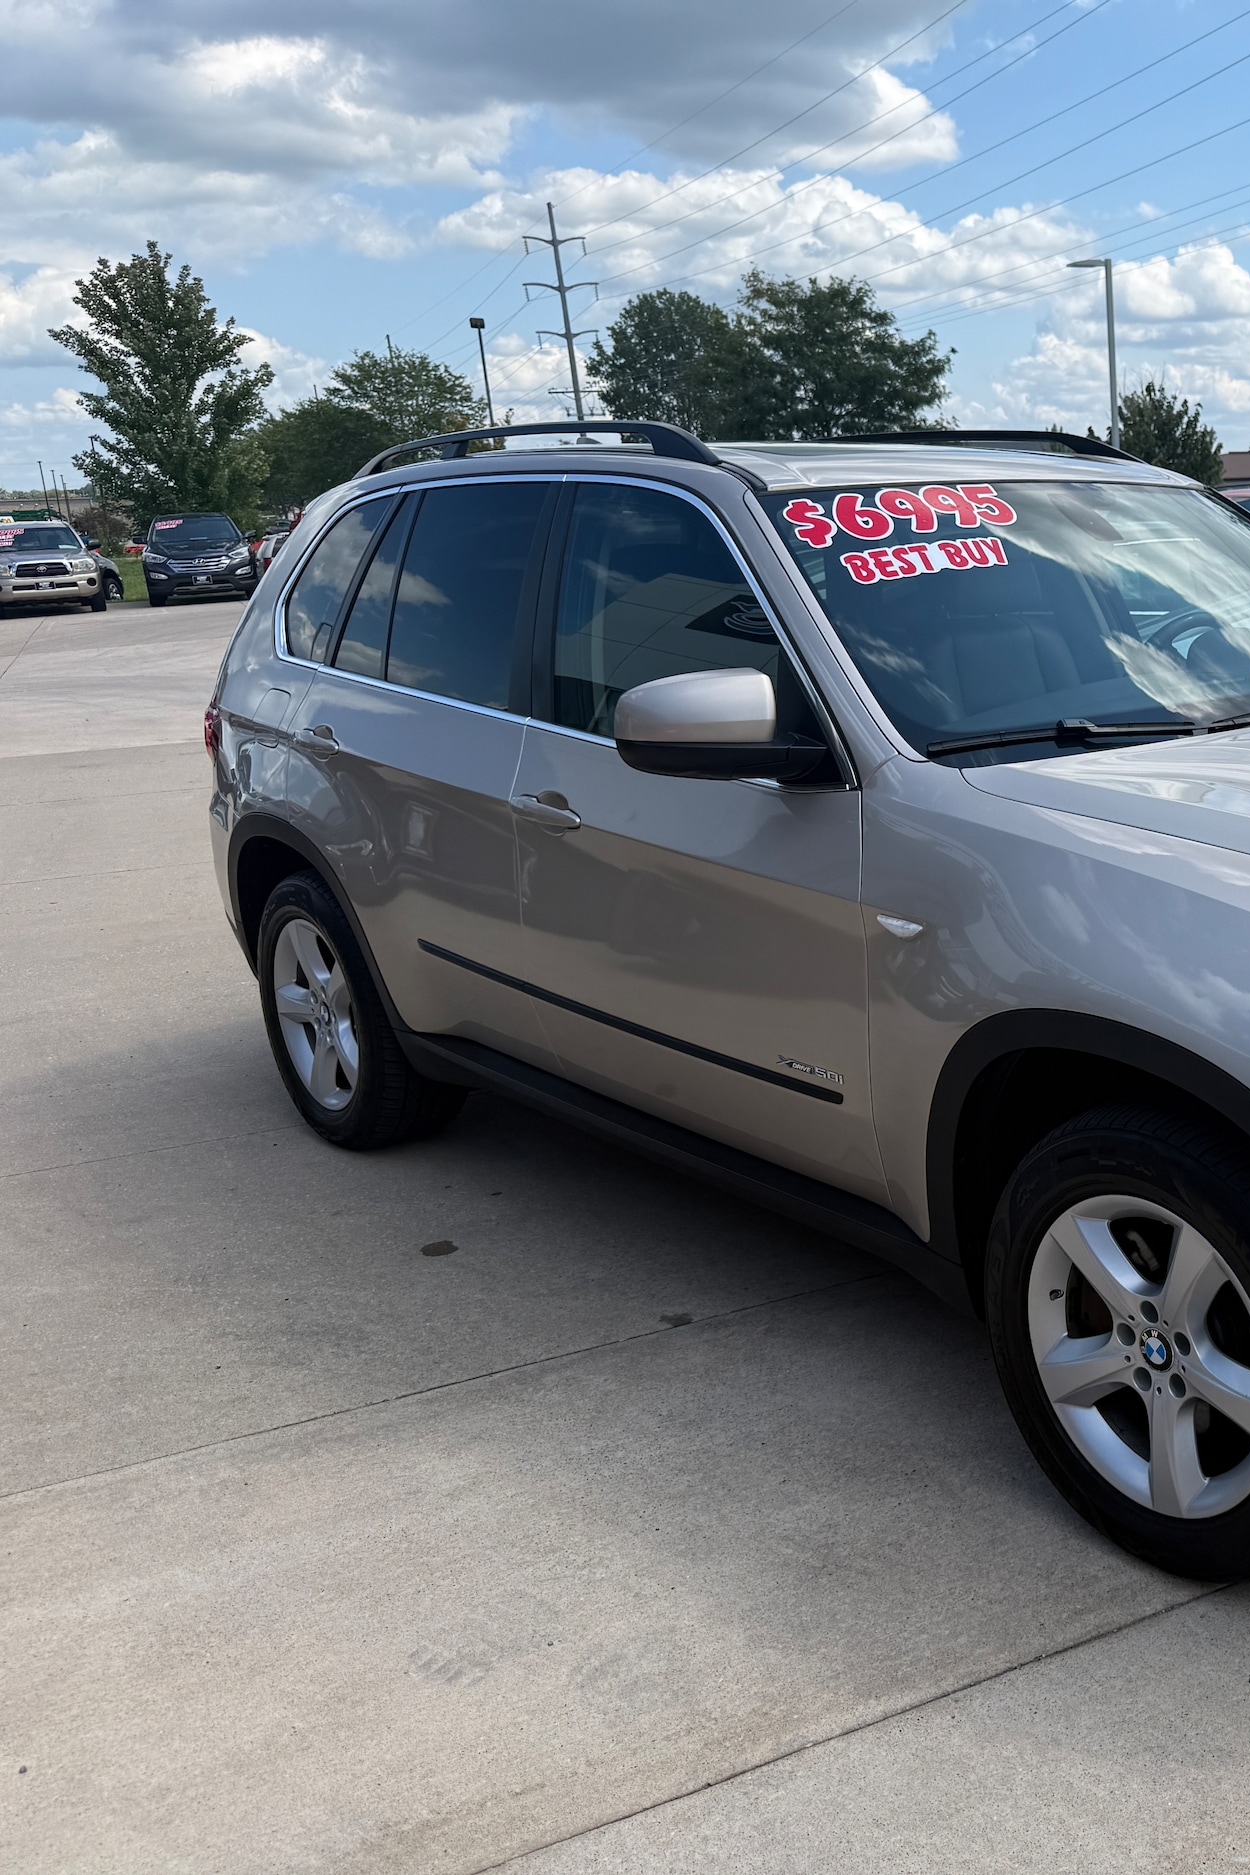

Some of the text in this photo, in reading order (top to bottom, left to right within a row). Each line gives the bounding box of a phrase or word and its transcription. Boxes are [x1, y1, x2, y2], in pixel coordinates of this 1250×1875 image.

[784, 484, 1017, 548] $6995
[841, 538, 1008, 583] BEST BUY
